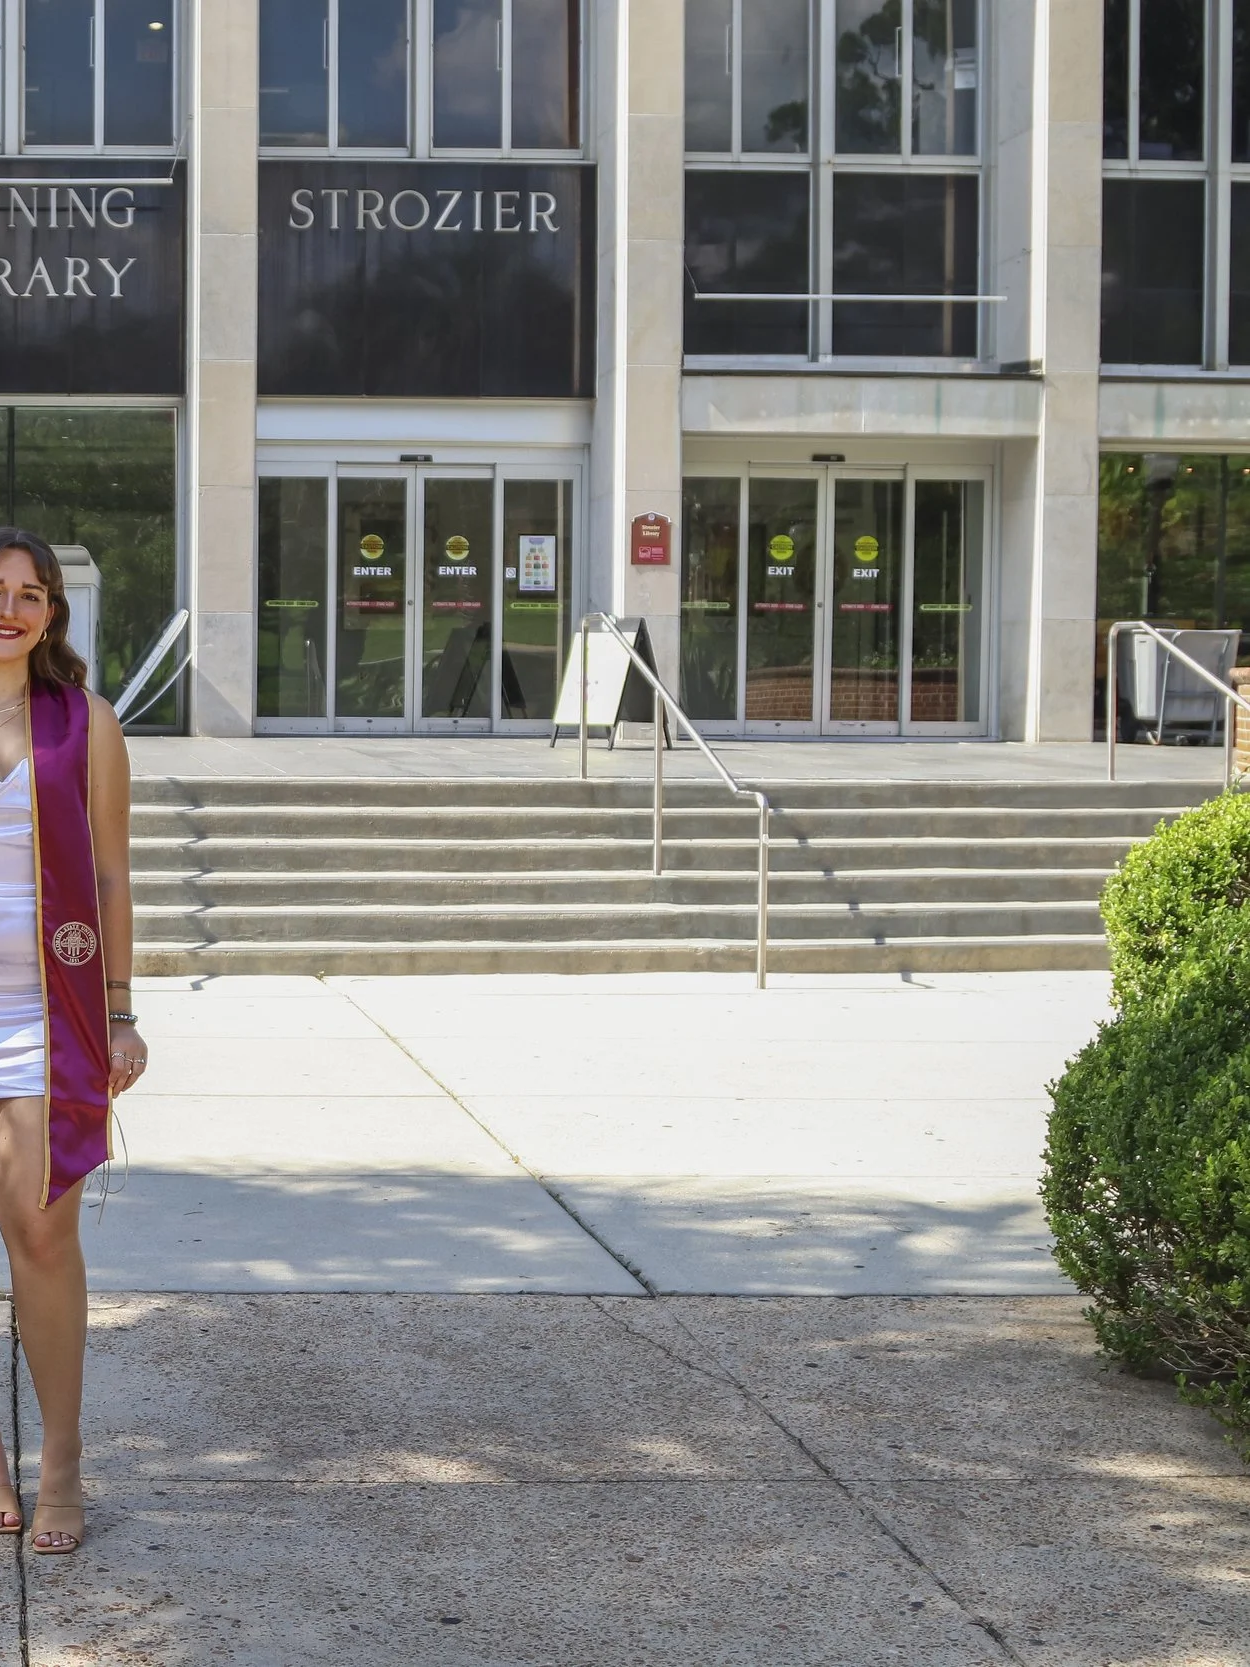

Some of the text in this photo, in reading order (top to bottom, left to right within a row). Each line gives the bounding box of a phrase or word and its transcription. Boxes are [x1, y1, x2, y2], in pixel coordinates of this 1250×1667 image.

[288, 188, 561, 232] STROZIER
[353, 566, 392, 576] ENTER
[438, 566, 477, 576] ENTER
[768, 566, 794, 575] EXIT
[853, 568, 880, 578] EXIT
[55, 924, 94, 955] FLORIDA STATE UNIVERSITY
